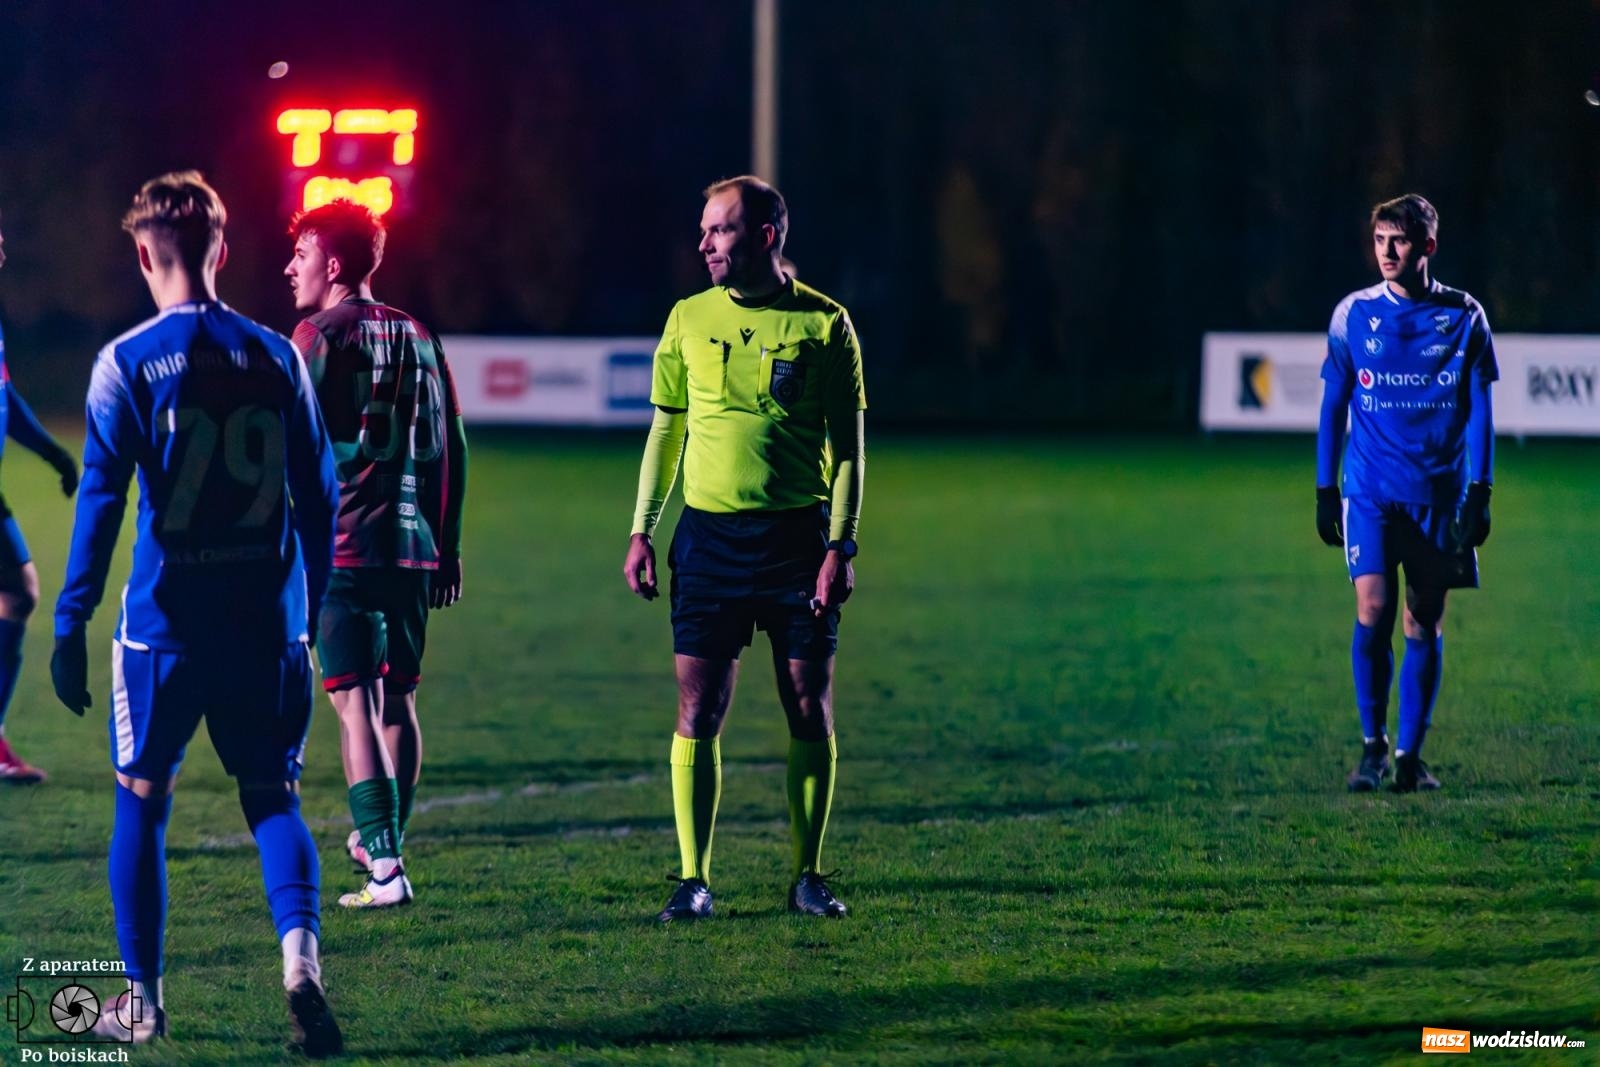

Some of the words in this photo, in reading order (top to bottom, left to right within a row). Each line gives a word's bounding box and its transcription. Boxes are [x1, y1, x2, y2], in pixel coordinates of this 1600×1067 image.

[142, 351, 189, 384] UNIA
[1527, 365, 1598, 404] BOXY
[157, 404, 284, 532] 79
